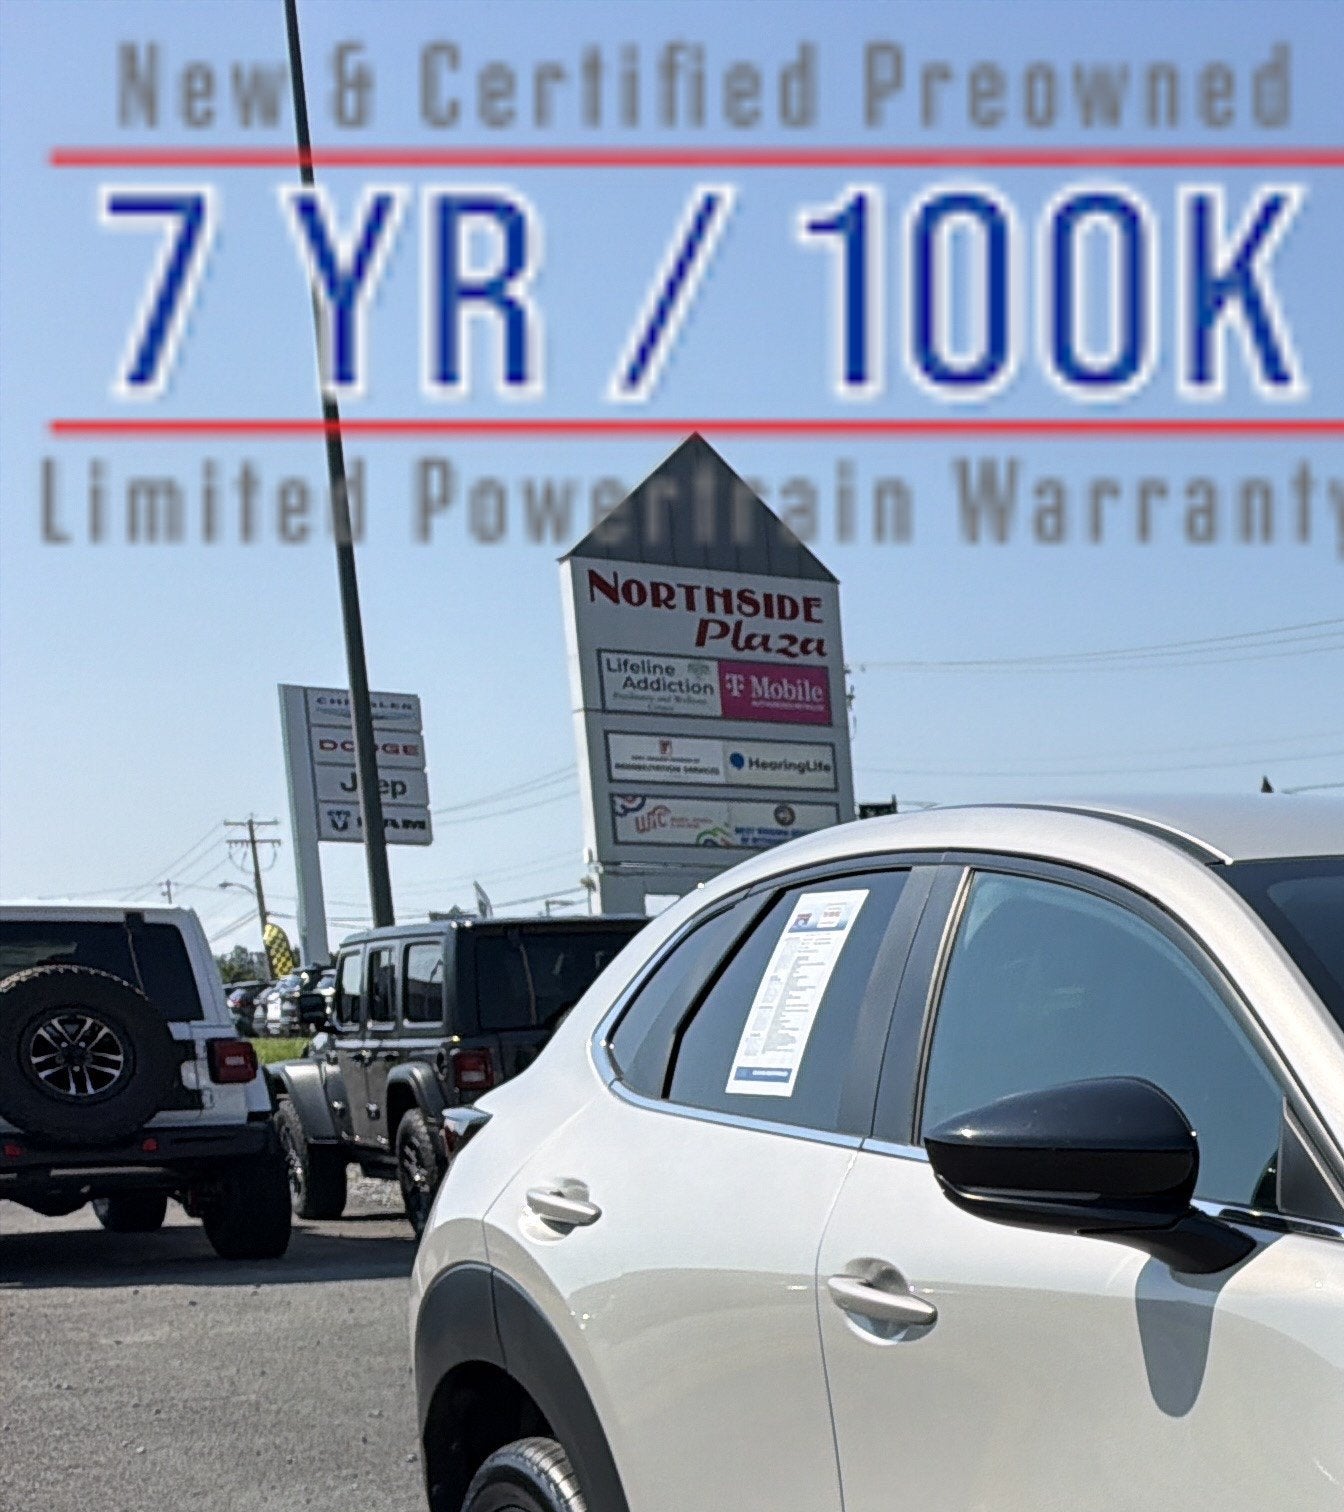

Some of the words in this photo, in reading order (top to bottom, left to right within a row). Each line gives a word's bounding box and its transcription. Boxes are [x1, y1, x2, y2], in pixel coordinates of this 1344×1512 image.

[587, 568, 824, 624] NORTHSIDE
[695, 617, 828, 658] Plaza
[606, 657, 676, 677] Lifeline
[622, 675, 715, 696] Addiction
[750, 674, 824, 703] Mobile
[318, 738, 419, 756] DOGE
[748, 756, 832, 776] HearingLife
[340, 771, 407, 799] Jep
